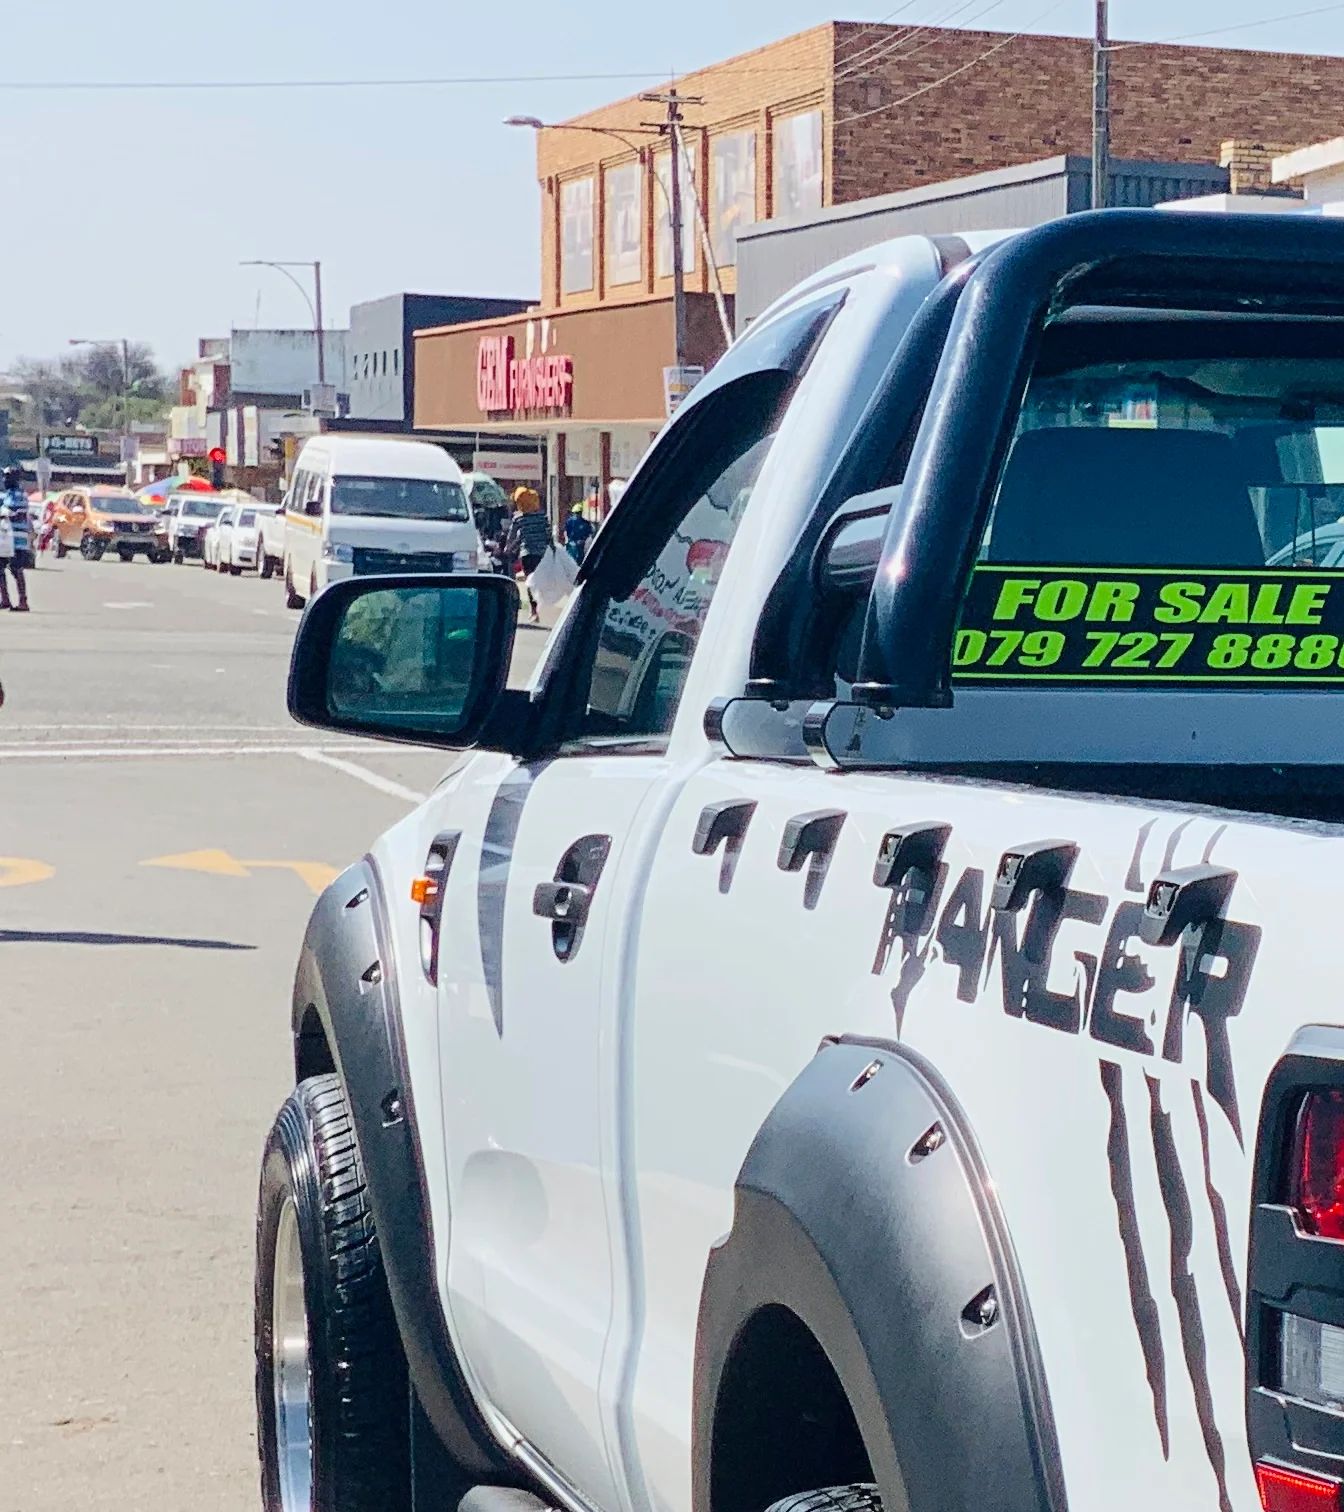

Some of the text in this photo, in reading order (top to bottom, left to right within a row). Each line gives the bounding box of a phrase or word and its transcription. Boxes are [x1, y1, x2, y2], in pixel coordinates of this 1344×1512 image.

[992, 579, 1331, 625] FOR SALE
[952, 630, 1067, 668] 079
[1081, 631, 1195, 669] 727
